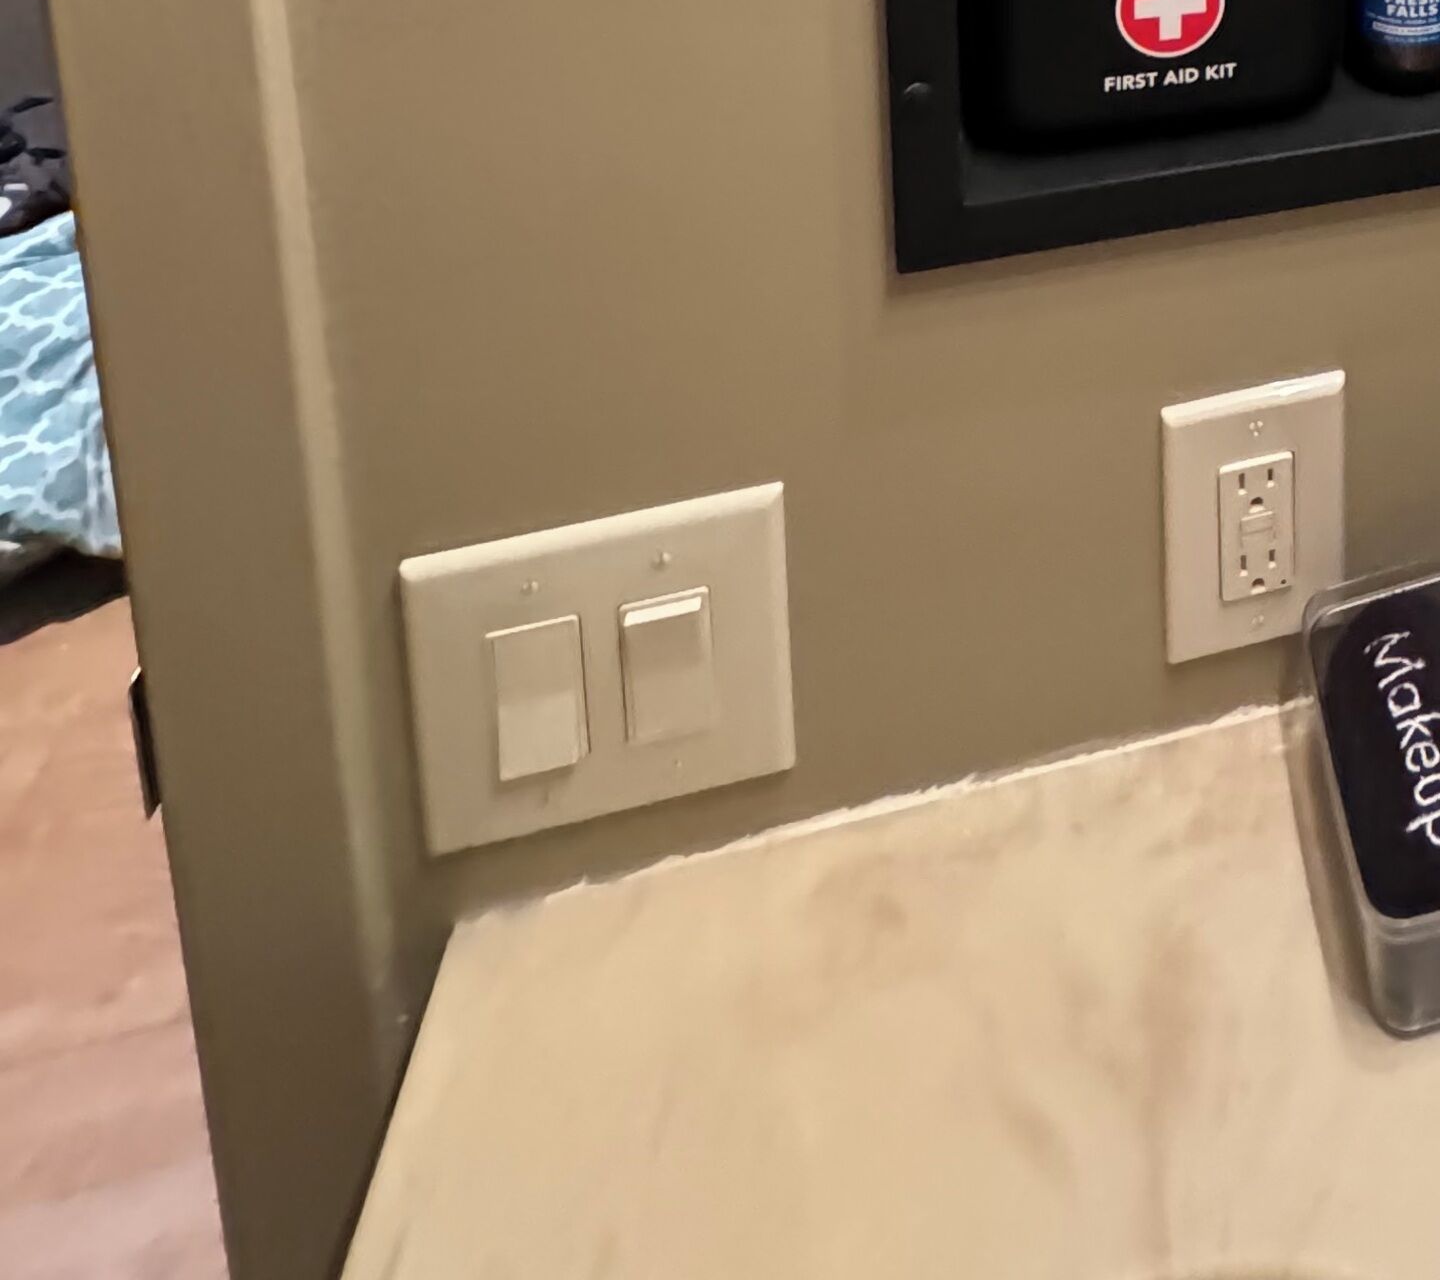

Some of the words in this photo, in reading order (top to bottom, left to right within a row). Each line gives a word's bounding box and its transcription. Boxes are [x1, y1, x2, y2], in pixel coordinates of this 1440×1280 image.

[1386, 3, 1439, 18] FALLS
[1104, 71, 1159, 93] FIRST
[1163, 67, 1199, 86] AID
[1205, 62, 1238, 81] KIT
